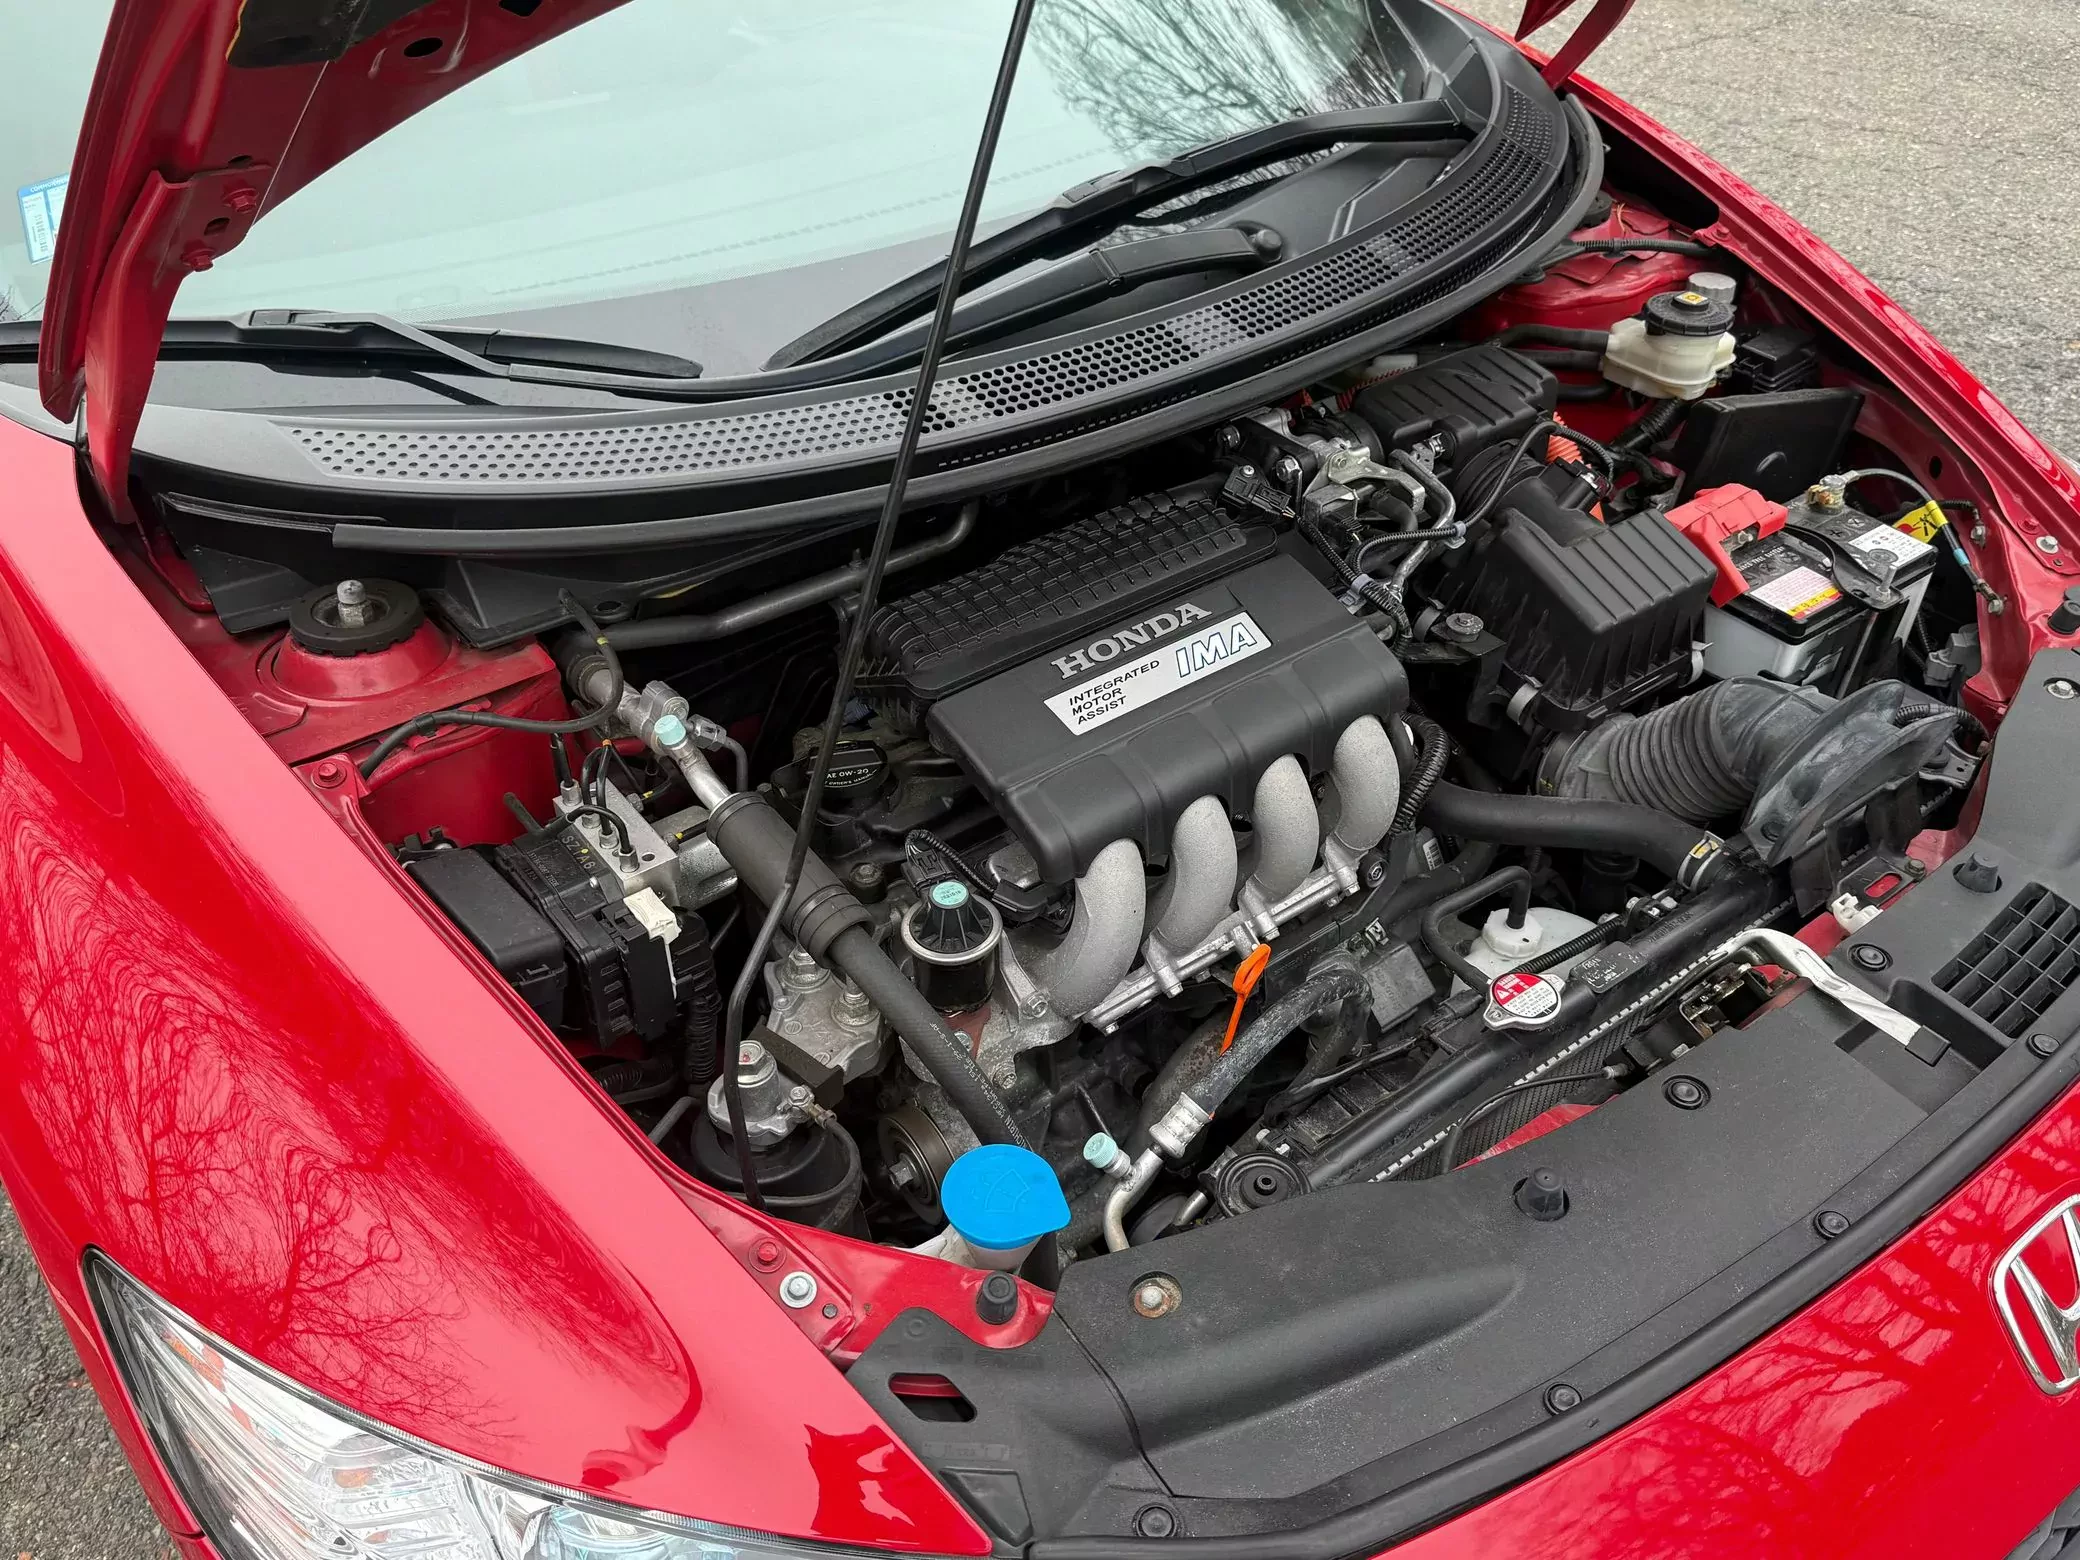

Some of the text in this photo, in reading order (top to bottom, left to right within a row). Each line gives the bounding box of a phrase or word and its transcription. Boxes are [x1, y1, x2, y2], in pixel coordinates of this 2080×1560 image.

[1051, 602, 1212, 680] HONDA
[1175, 621, 1257, 678] IMA
[1068, 660, 1160, 706] INTEGRATED
[1071, 688, 1123, 716] MOTOR
[1077, 696, 1127, 725] ASSIST
